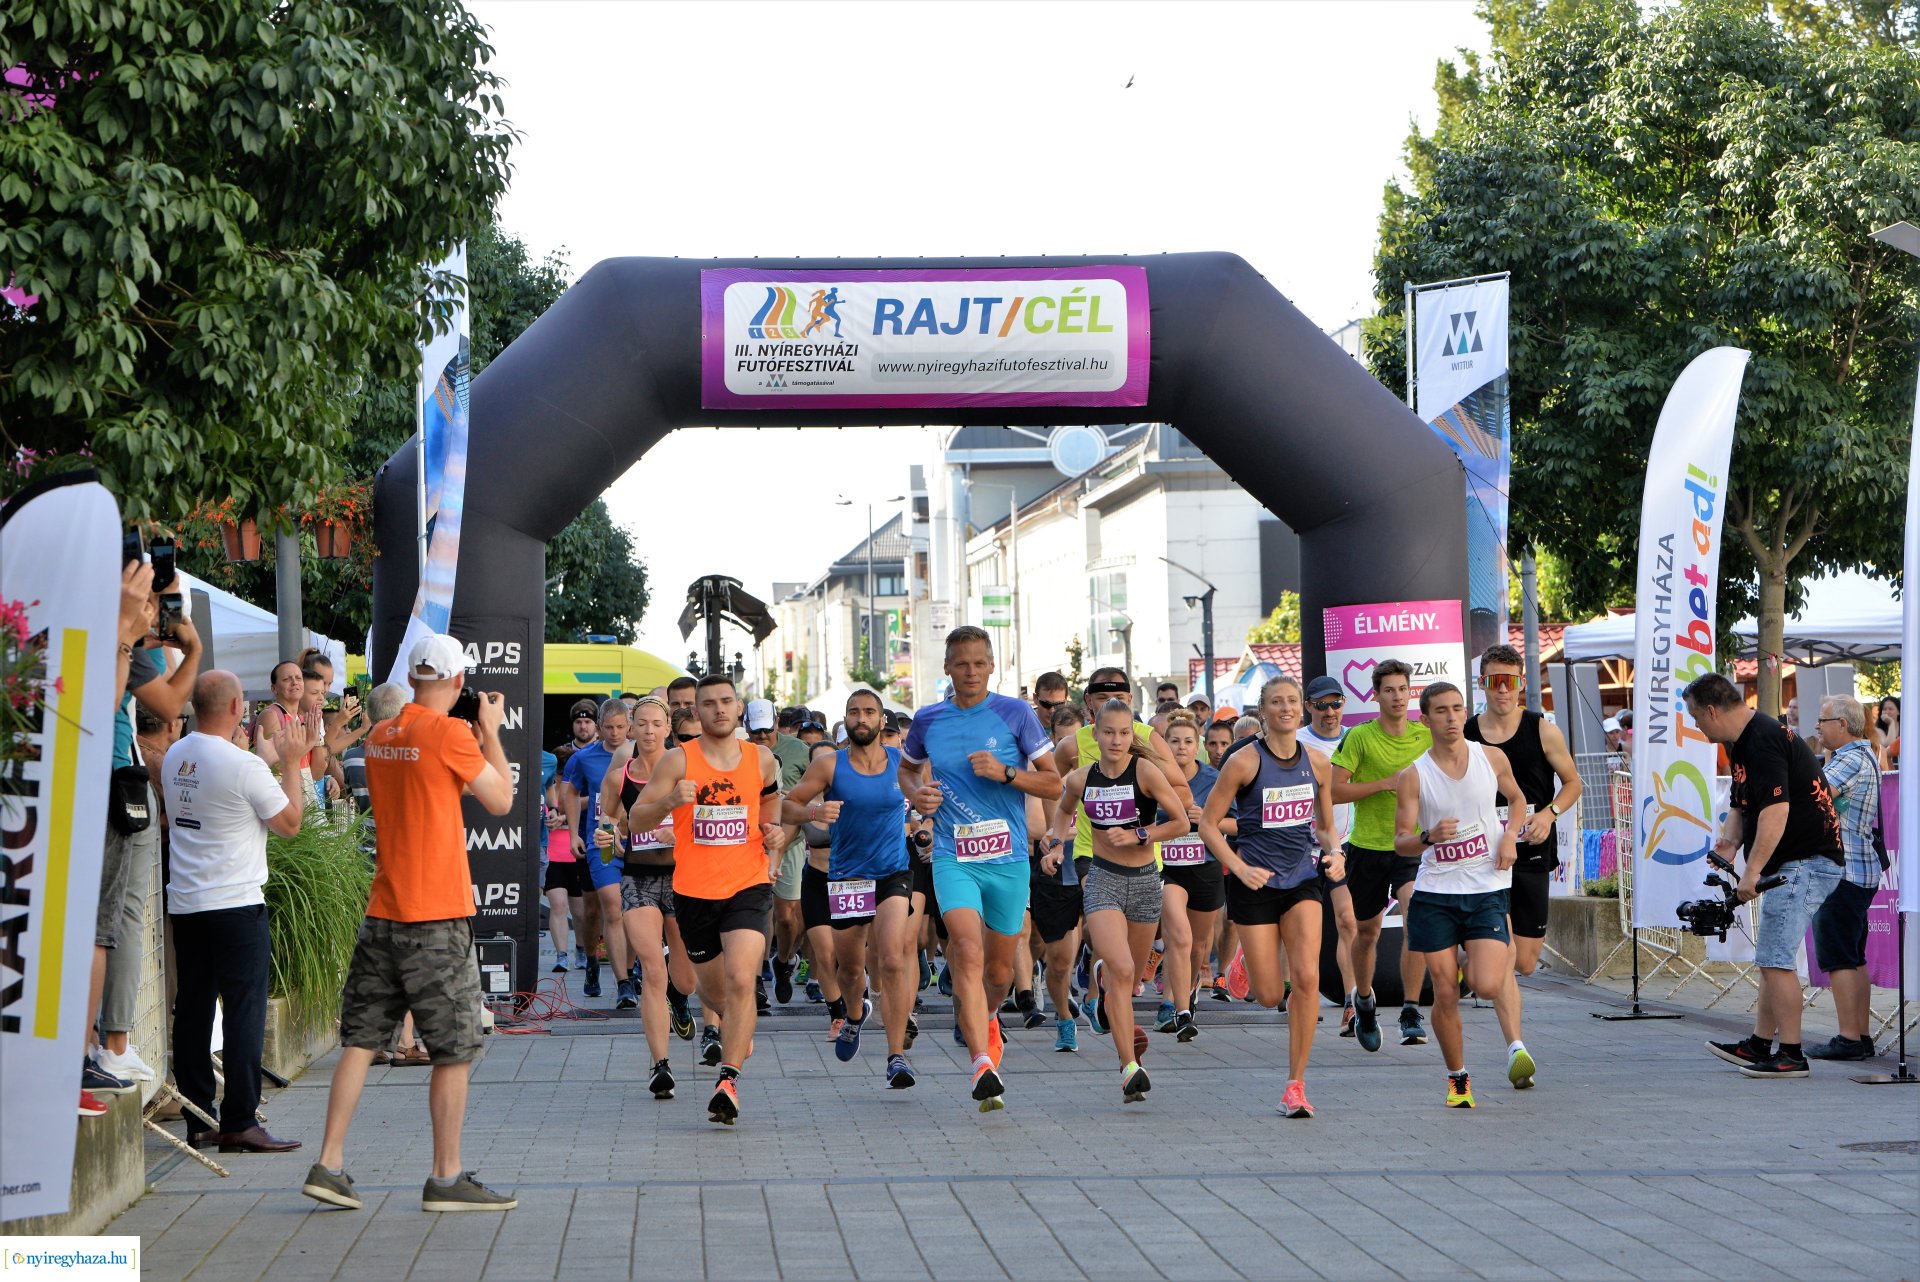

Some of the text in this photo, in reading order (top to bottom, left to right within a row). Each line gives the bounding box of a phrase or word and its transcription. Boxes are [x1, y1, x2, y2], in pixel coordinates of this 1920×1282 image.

[873, 287, 1113, 337] RAJT/CÉL
[735, 341, 859, 357] III. NYÍREGYHÁZI
[737, 357, 855, 372] FUTÓFESZTIVÁL
[878, 357, 1108, 376] www.nyiregyhazifutofesztival.hu
[1451, 360, 1474, 371] WITTUR
[1675, 463, 1718, 748] Tbbet ad!
[1354, 610, 1440, 635] ÉLMÉNY.
[1649, 533, 1675, 744] NYÍREGYHÁZA
[482, 667, 519, 675] TIMING
[1095, 802, 1122, 818] 557
[1265, 801, 1312, 820] 10167
[696, 821, 745, 838] 10009
[957, 834, 1009, 854] 10027
[1162, 846, 1202, 859] 10181
[1436, 837, 1486, 860] 10104
[838, 894, 865, 911] 545
[482, 908, 518, 916] TIMING
